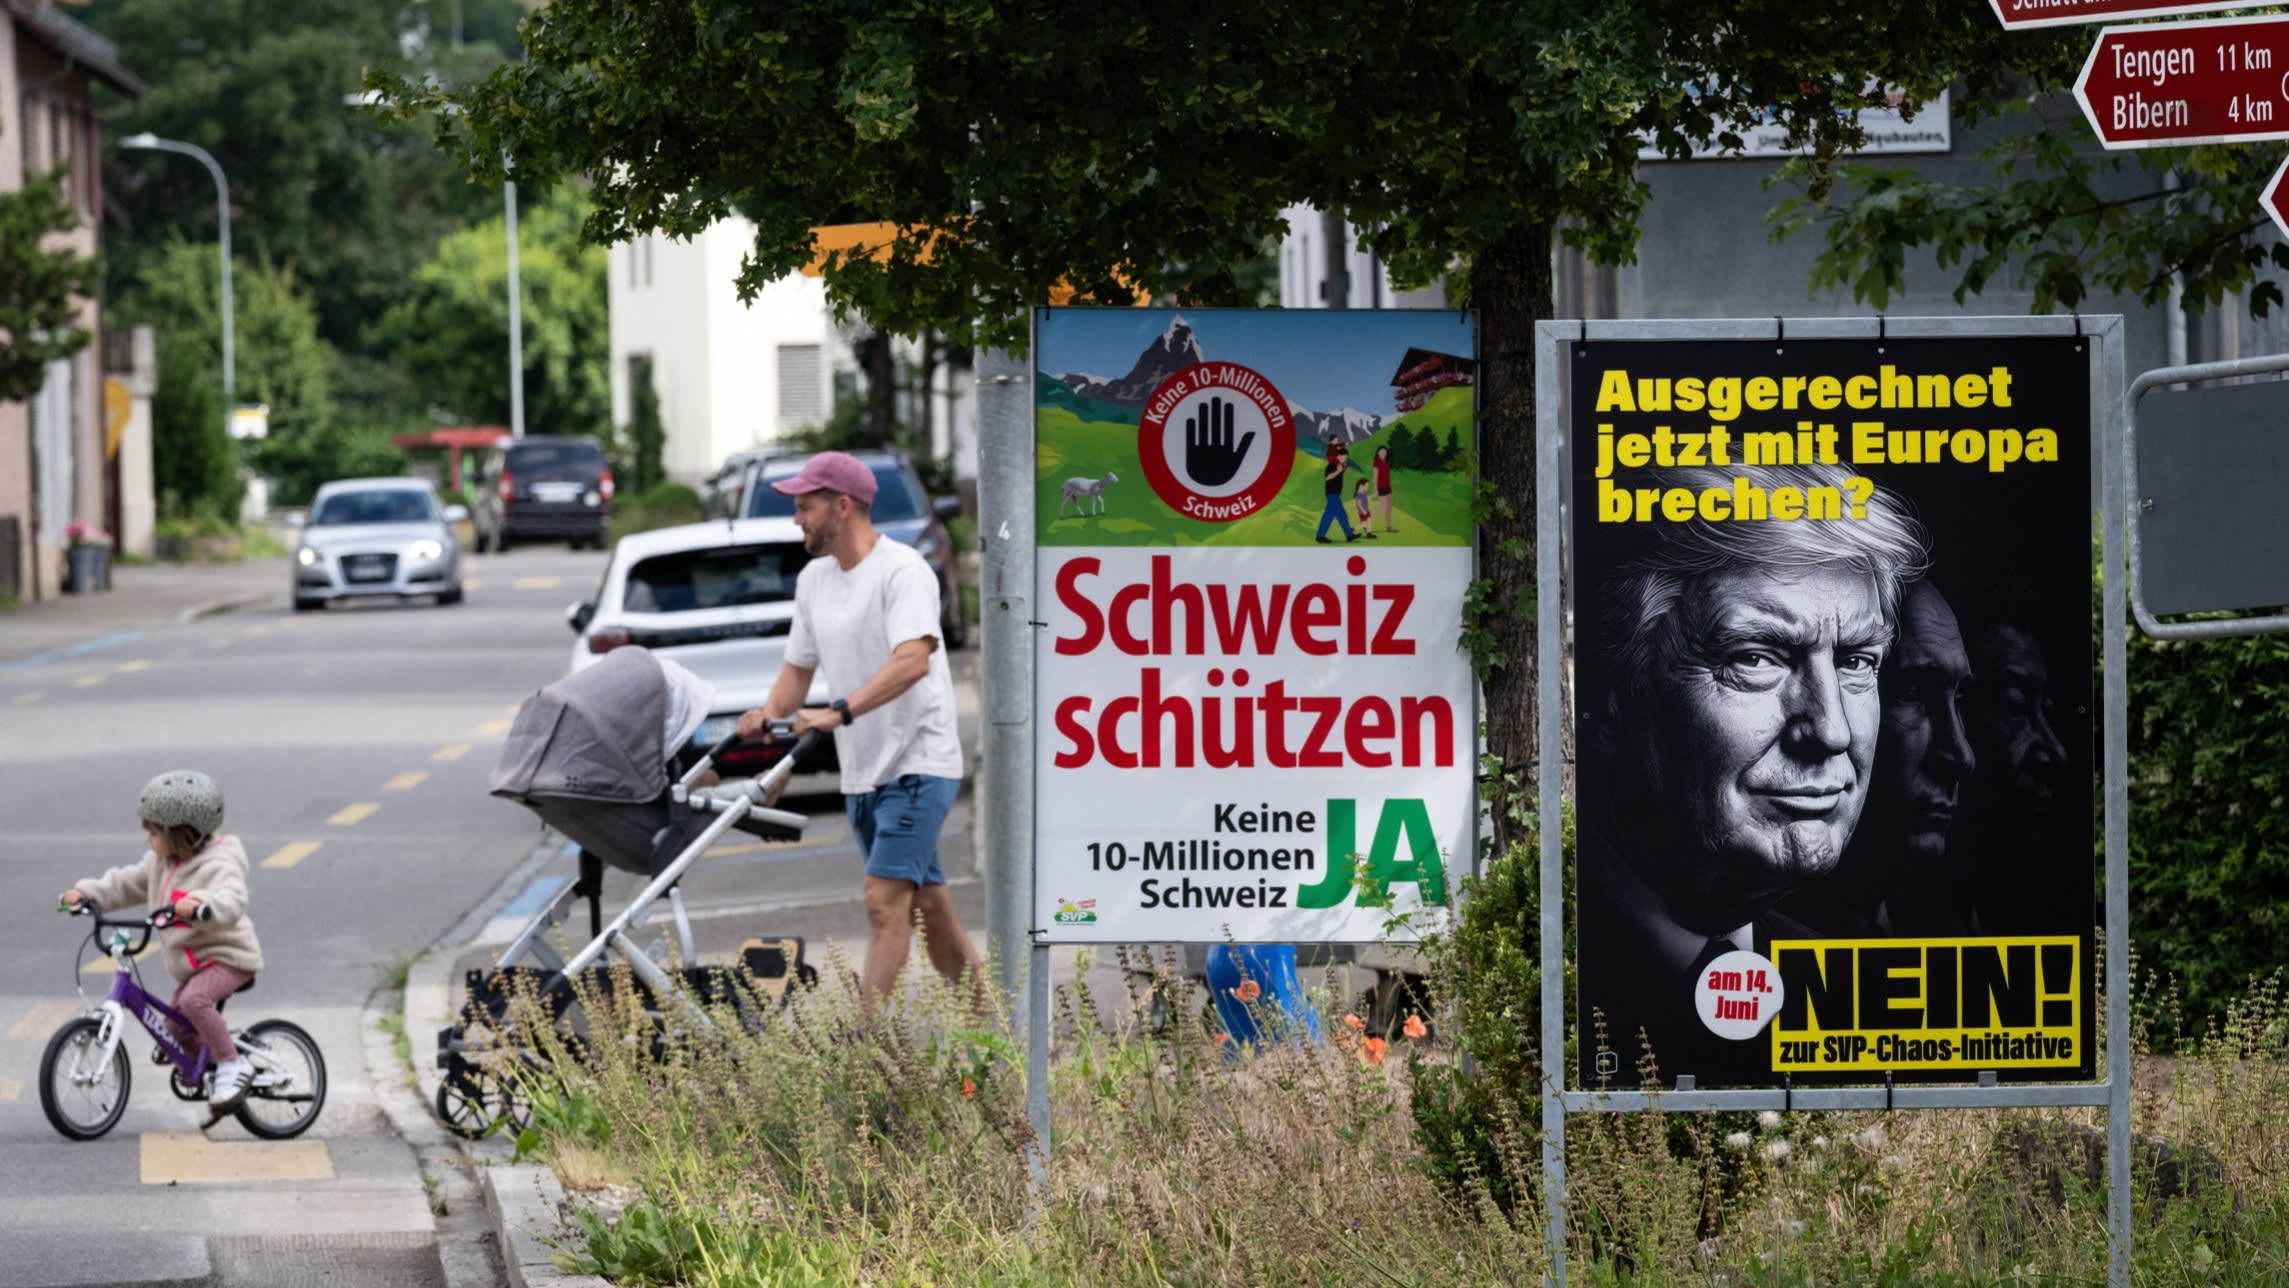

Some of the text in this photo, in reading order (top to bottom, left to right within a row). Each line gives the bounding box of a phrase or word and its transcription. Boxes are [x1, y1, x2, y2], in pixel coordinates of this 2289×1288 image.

[2111, 41, 2272, 86] Tengen 11 km
[2113, 92, 2273, 130] Bibern 4 km
[1145, 366, 1286, 428] Keine 10-Millionen
[1595, 365, 2013, 421] Ausgerechnet
[1594, 421, 2058, 478] jetzt mit Europa
[1183, 495, 1257, 519] Schweiz
[1598, 476, 1875, 523] brechen?
[1054, 555, 1416, 656] Schweiz
[1053, 667, 1454, 768] schützen
[1214, 803, 1315, 833] Keine
[1086, 840, 1315, 871] 10-Millionen
[1296, 798, 1447, 909] JA
[1140, 877, 1287, 909] Schweiz
[1061, 911, 1089, 921] SVP
[1708, 969, 1773, 993] am 14.
[1778, 944, 2073, 1031] NEIN!
[1715, 996, 1759, 1021] Juni
[1780, 1032, 2073, 1063] zur SVP-Chaos-Initiative
